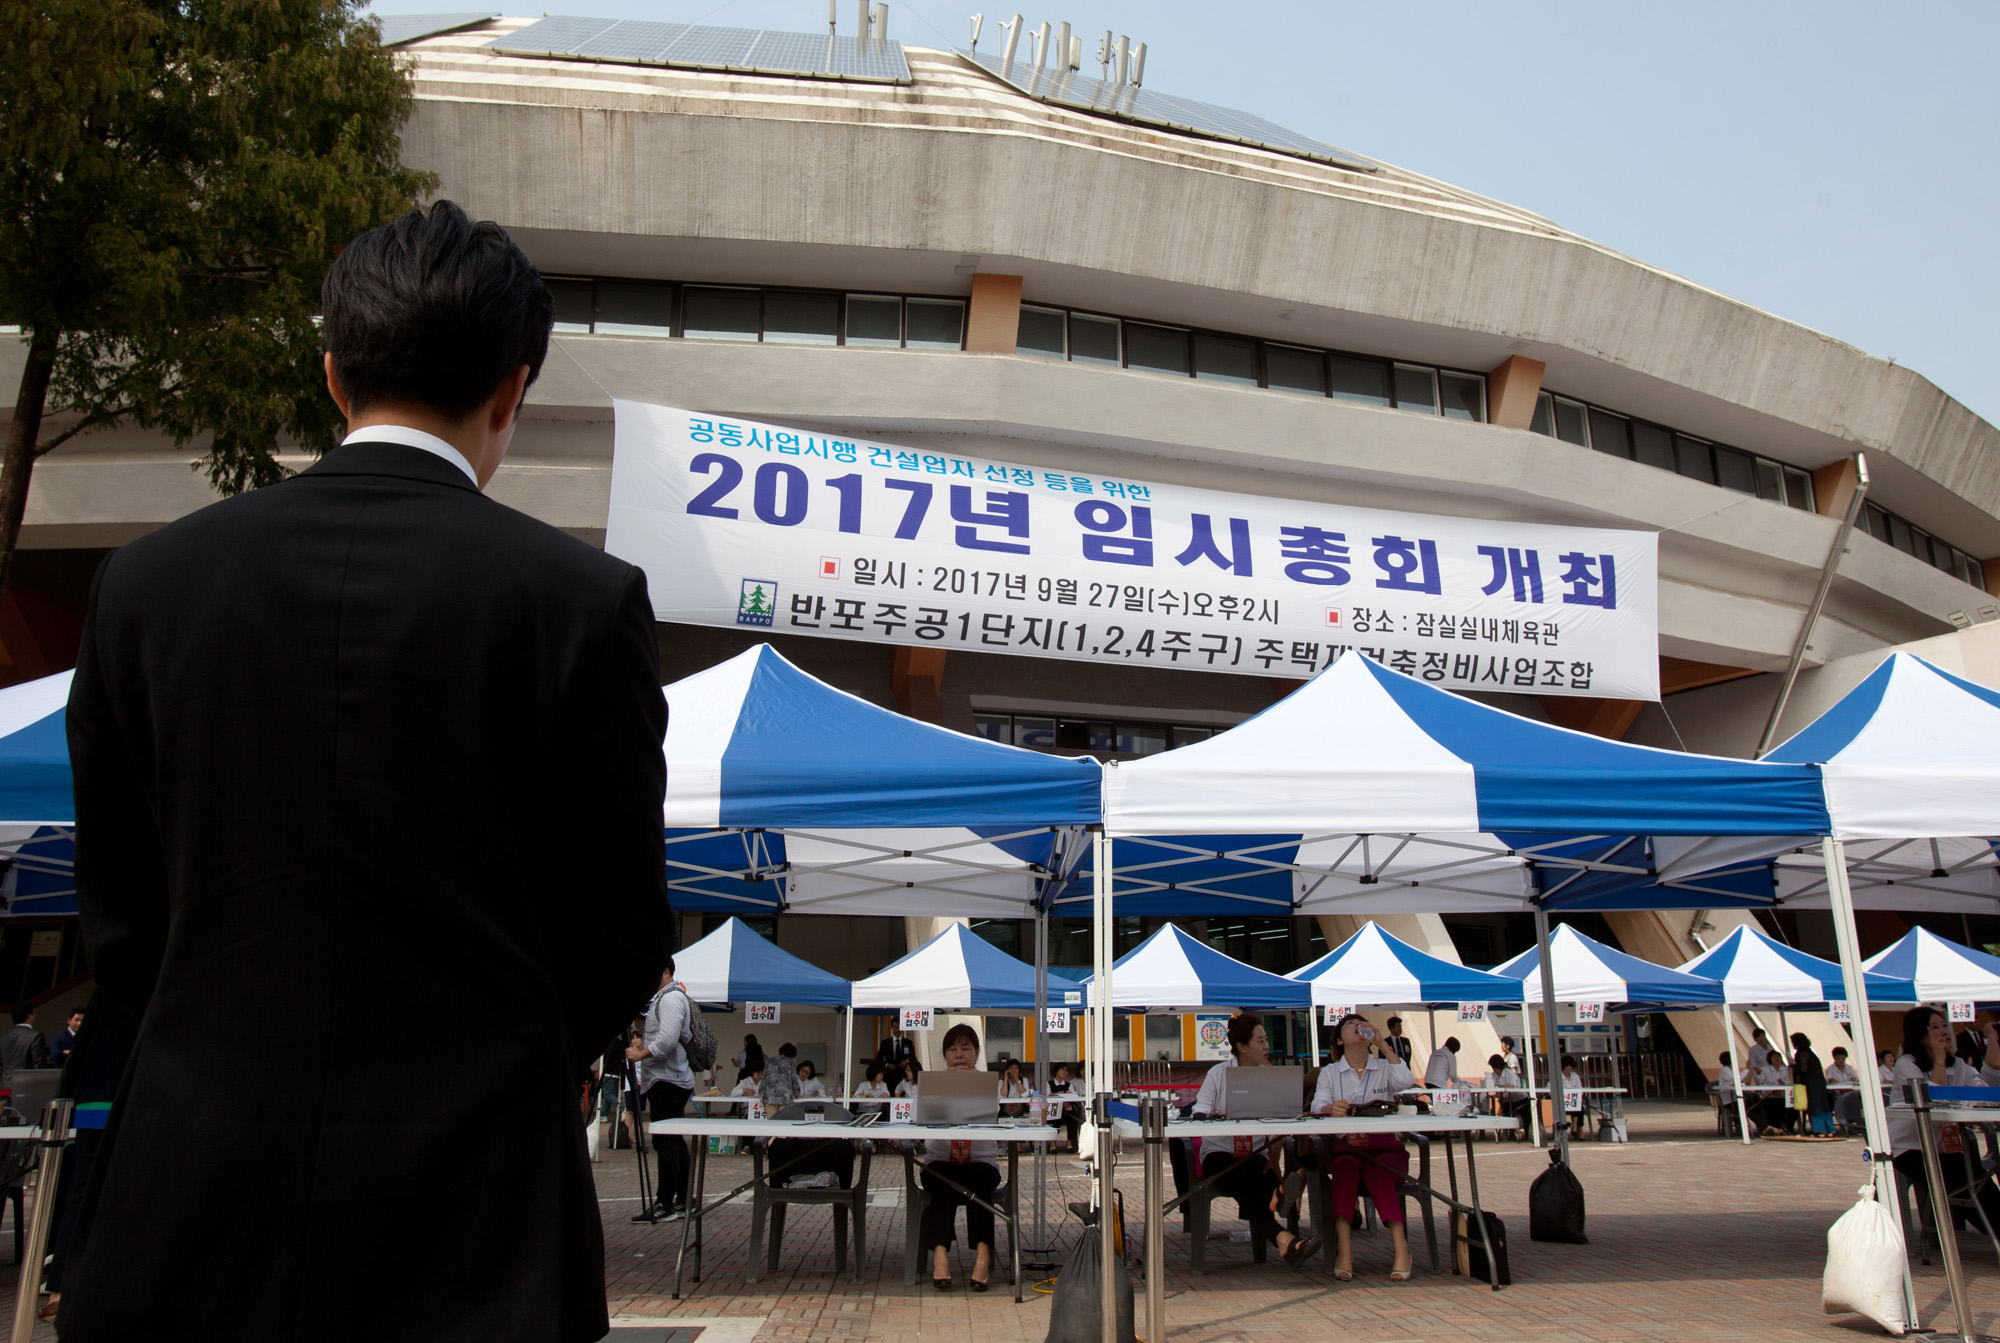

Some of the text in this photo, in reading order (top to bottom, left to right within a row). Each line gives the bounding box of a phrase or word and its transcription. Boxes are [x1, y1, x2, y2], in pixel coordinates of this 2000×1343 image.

[689, 418, 1151, 502] 공동사업시행 건설업자 선정 등을 위한
[686, 452, 1030, 555] 2017년
[1477, 545, 1617, 610] 개최
[933, 566, 1027, 600] 2017년
[1038, 577, 1078, 606] 9월
[739, 615, 771, 625] BANPO
[1416, 612, 1560, 646] 잠실실내체육관
[750, 1005, 775, 1013] 4-9번
[1329, 1006, 1351, 1014] 4-6번
[904, 1011, 929, 1019] 4-8번
[905, 1019, 928, 1027] 접수대
[1437, 1093, 1458, 1101] 4-5번
